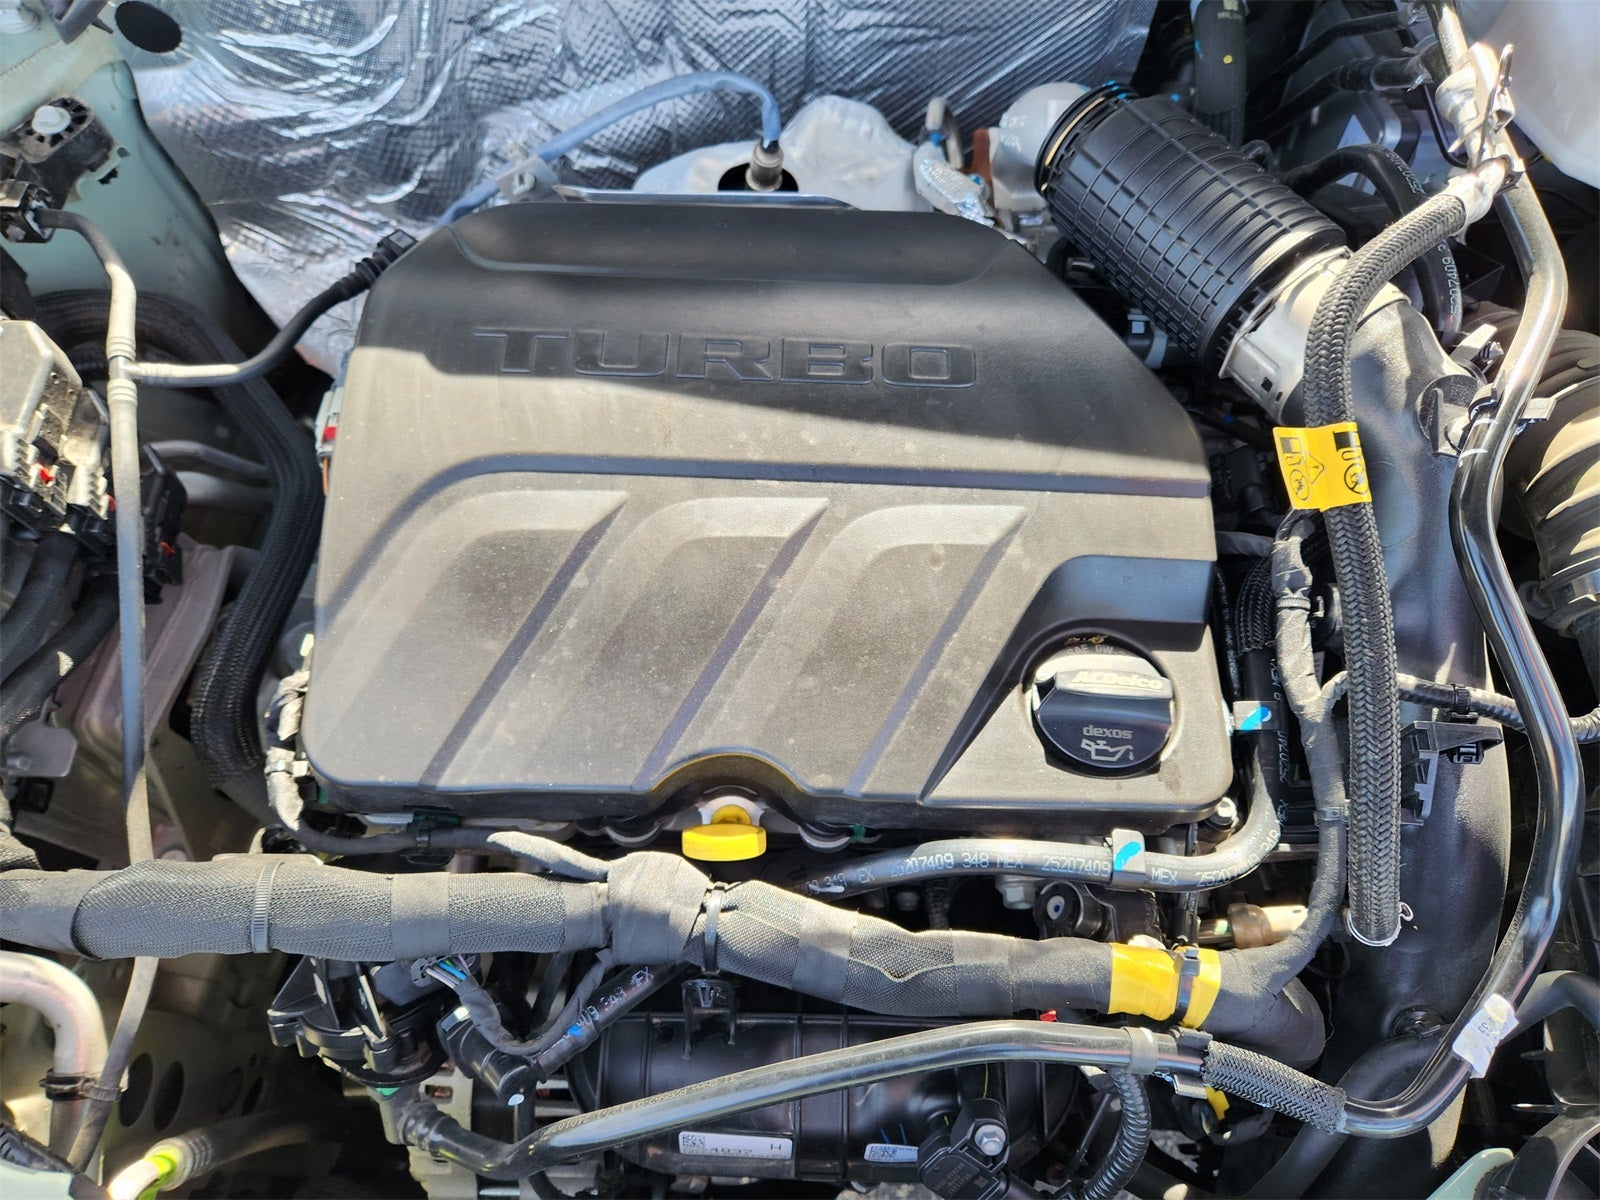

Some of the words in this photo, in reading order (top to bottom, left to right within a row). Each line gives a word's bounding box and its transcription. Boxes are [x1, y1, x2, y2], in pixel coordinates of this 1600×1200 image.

[474, 327, 977, 389] TURBO
[1071, 671, 1164, 690] ACDelco
[1082, 724, 1134, 739] dexos
[961, 851, 989, 869] 348
[996, 852, 1025, 870] MEX
[1041, 855, 1112, 878] 25207409
[1151, 868, 1178, 884] MEX
